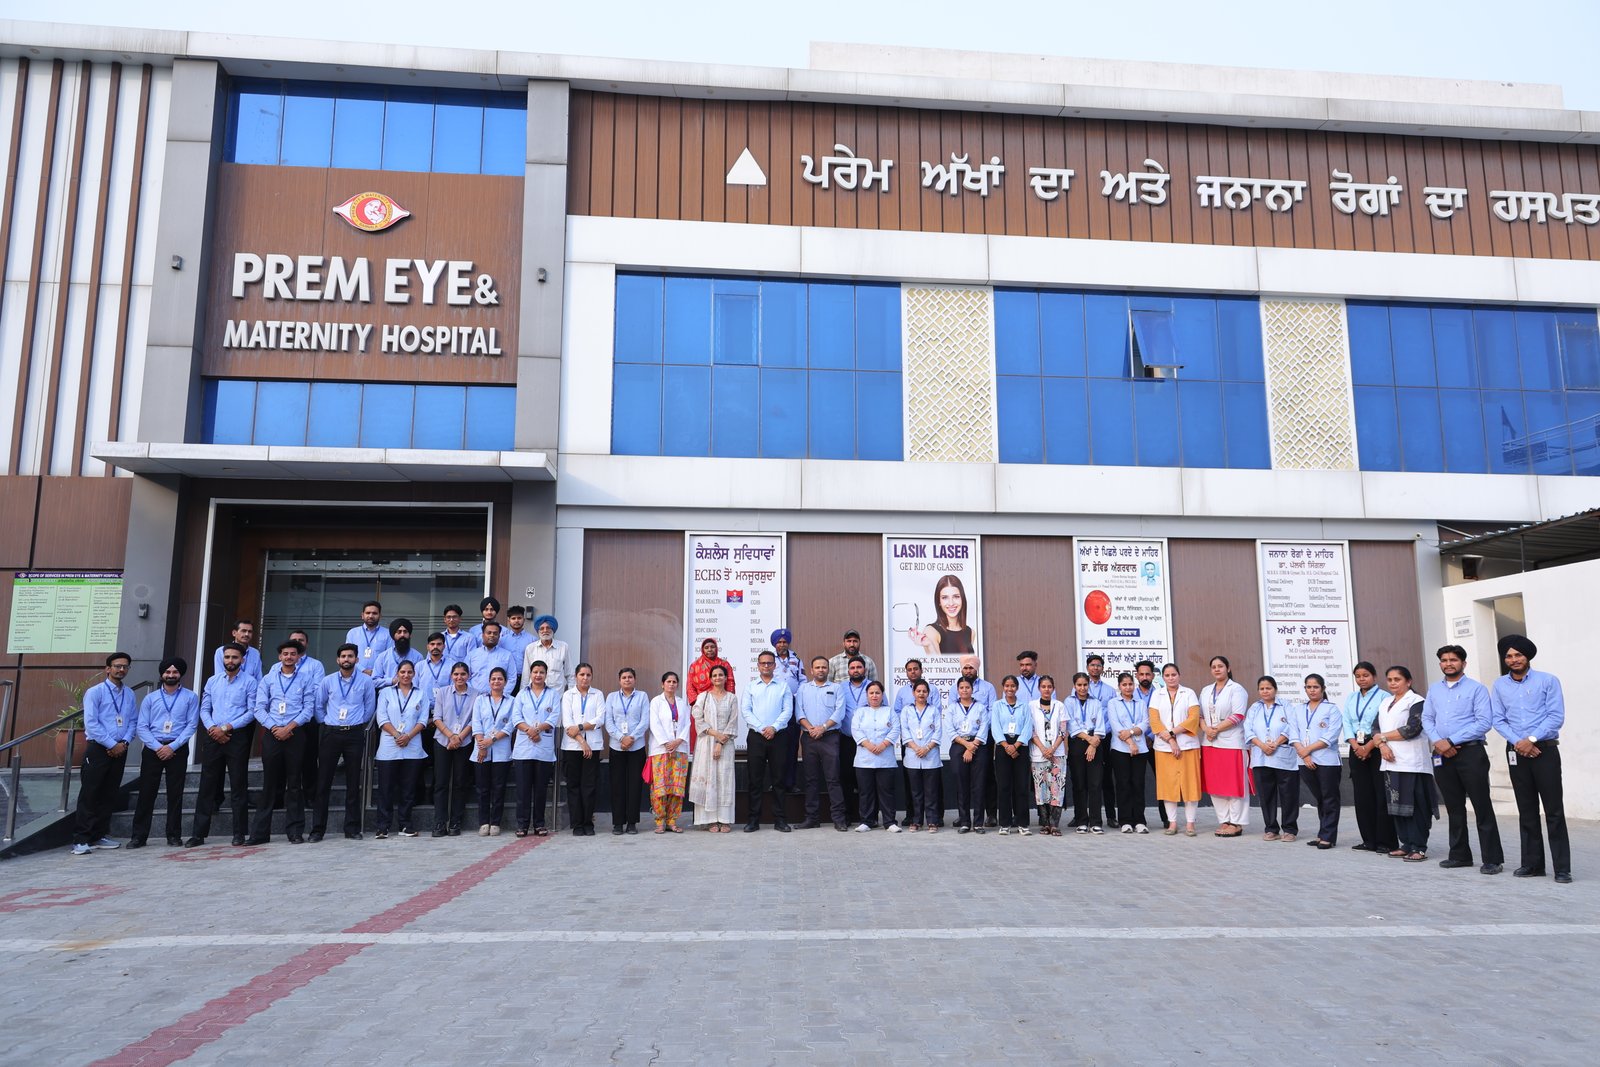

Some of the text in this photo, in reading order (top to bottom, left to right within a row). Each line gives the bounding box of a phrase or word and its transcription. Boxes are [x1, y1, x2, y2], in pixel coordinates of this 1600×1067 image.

[921, 153, 1005, 197] ਅੱਖਾਂ
[1029, 167, 1075, 200] ਦਾ
[1100, 158, 1170, 205] ਅਤੇ
[1196, 175, 1307, 212] ਜਨਾਨਾ
[1330, 168, 1403, 217] ਰੋਗਾਂ
[1424, 186, 1468, 219] ਦਾ
[232, 252, 370, 302] PREM
[223, 319, 502, 356] MATERNITY HOSPITAL
[894, 544, 968, 559] LASIK LASER
[900, 562, 913, 570] GET
[914, 562, 925, 571] RID
[937, 563, 963, 571] GLASSES
[695, 569, 722, 581] ECHS
[1277, 625, 1336, 635] ਅੱਖਾਂ ਦੇ ਮਾਹਿਰ
